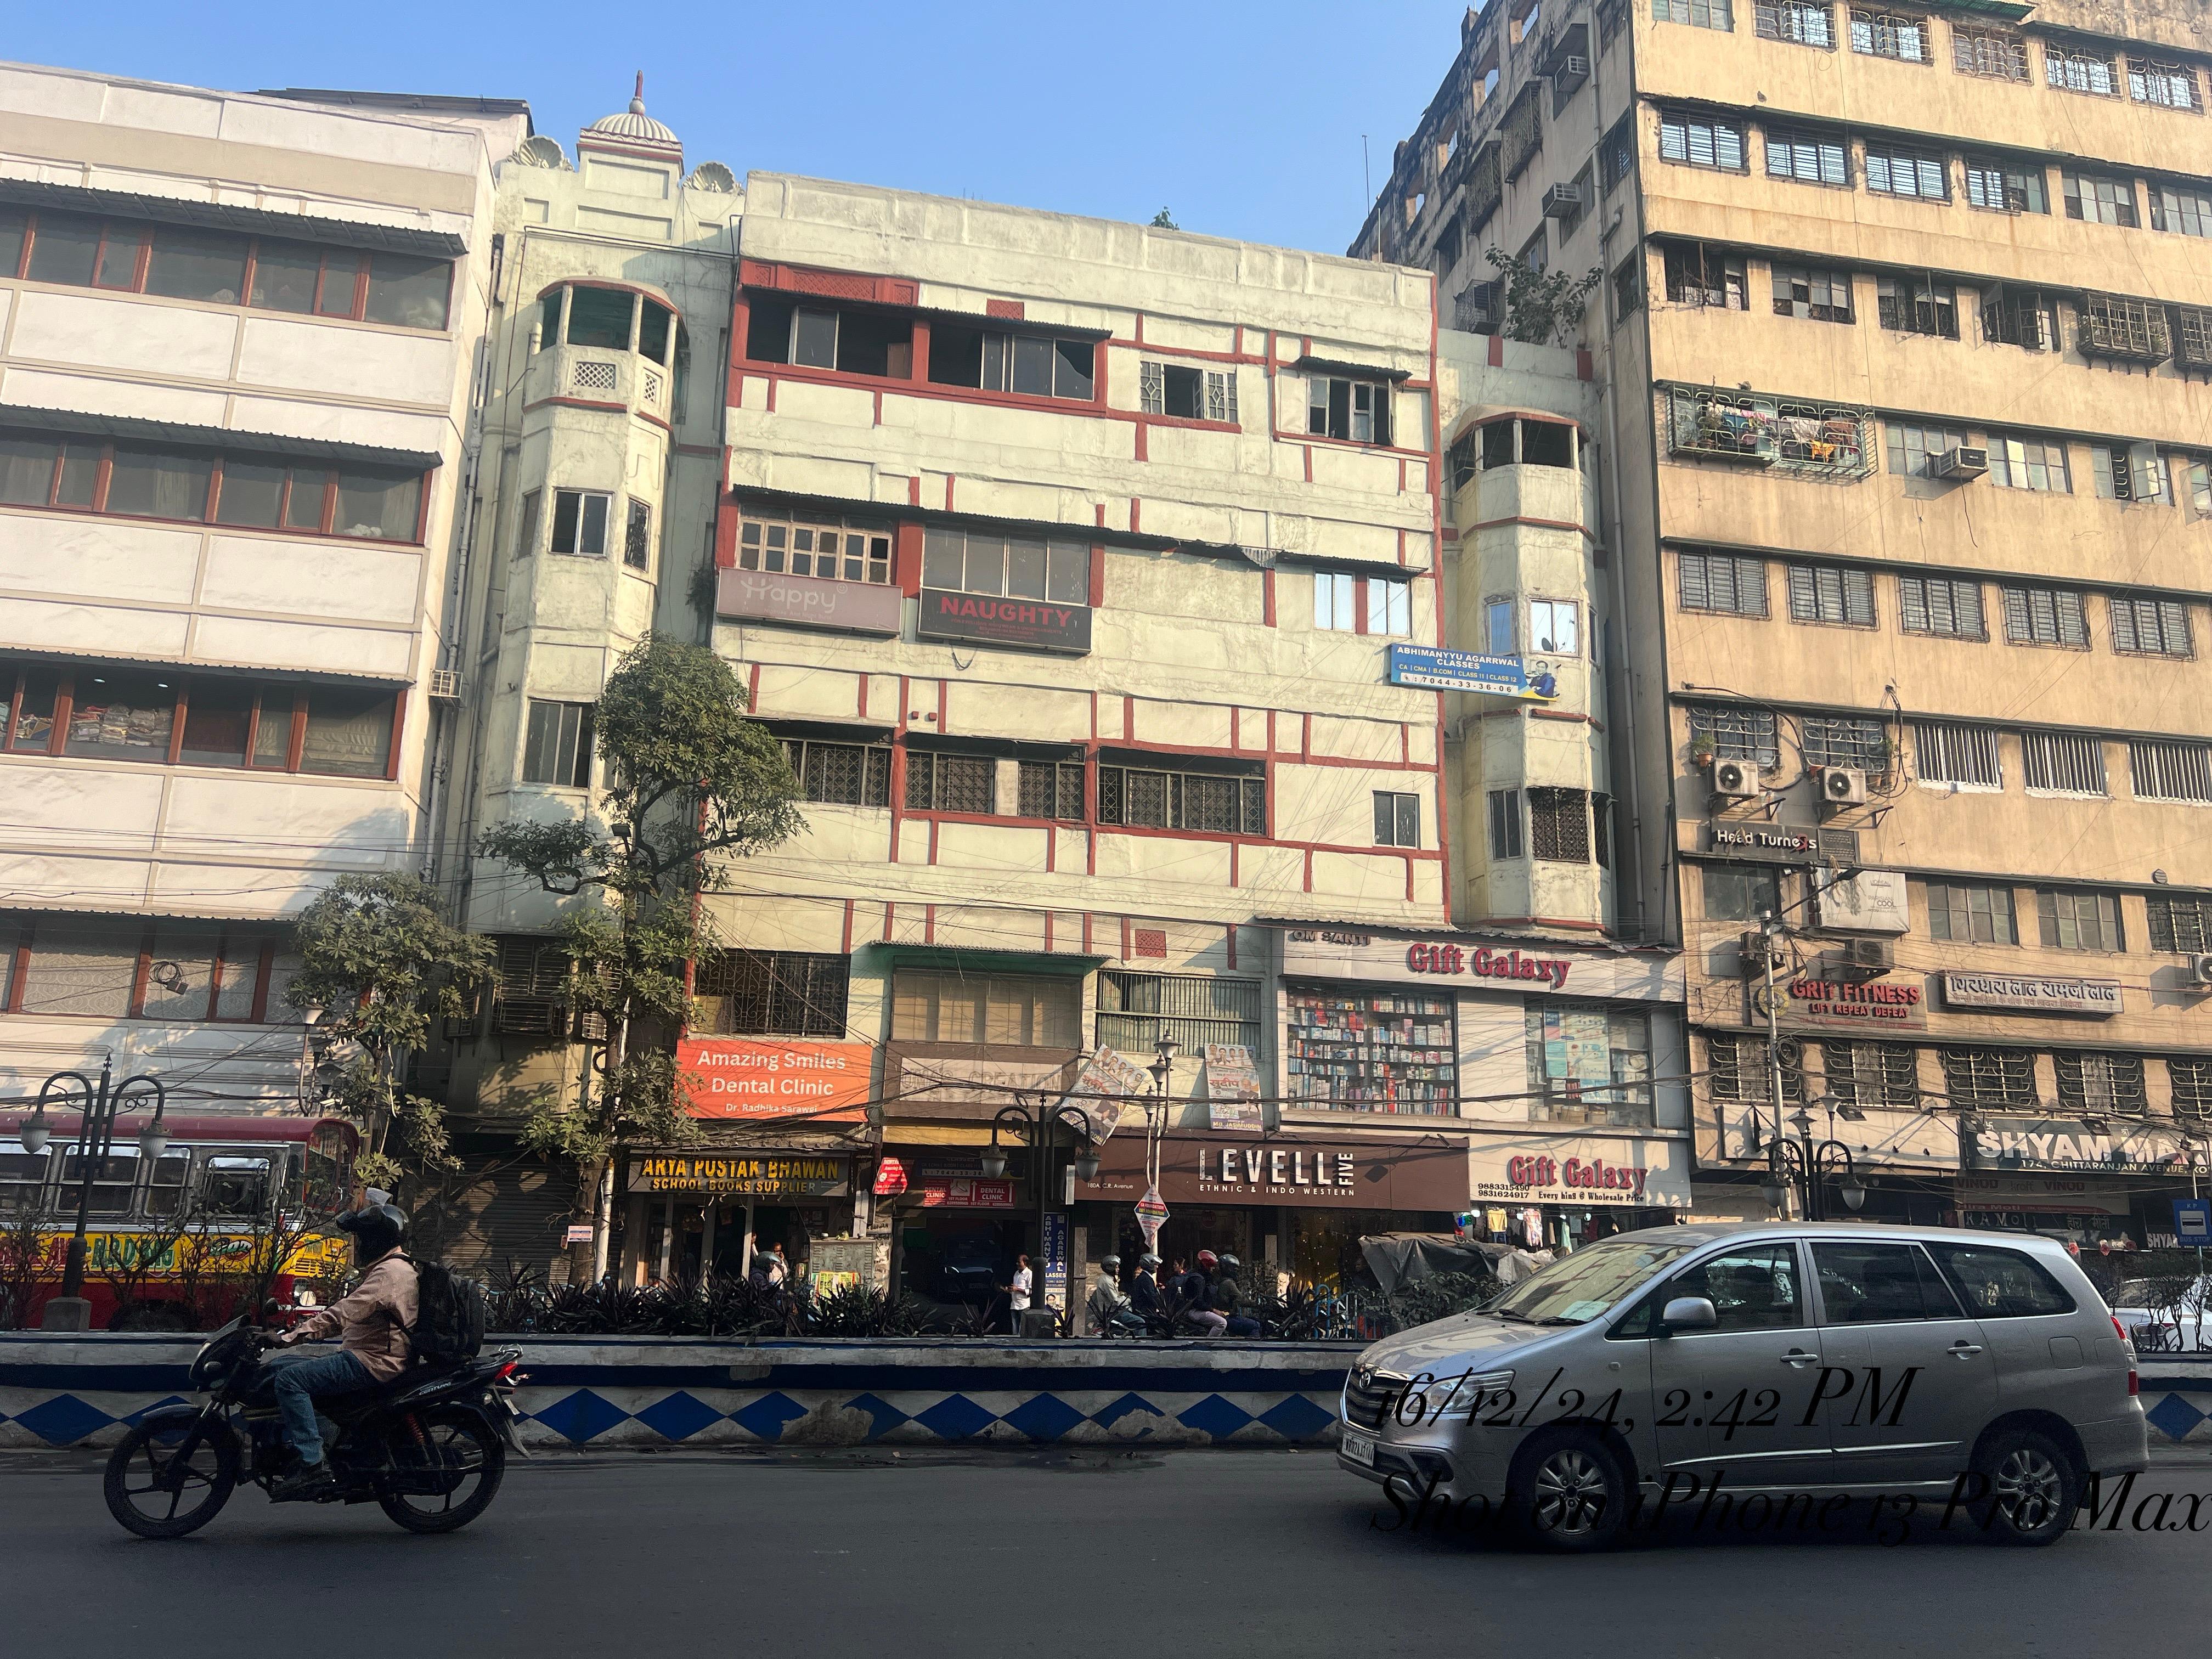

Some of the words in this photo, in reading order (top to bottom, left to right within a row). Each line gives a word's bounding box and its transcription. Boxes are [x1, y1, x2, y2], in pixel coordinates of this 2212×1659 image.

[741, 577, 836, 614] Happy
[940, 596, 1073, 628] NAUGHTY
[1397, 647, 1463, 661] ABHIMANYYU
[1465, 654, 1519, 667] AGARRWAL
[1436, 658, 1480, 669] CLASSES
[1717, 829, 1753, 844] Head
[1293, 930, 1318, 940] OM
[1409, 942, 1465, 974] Gift
[1475, 946, 1572, 988] Galaxy
[1792, 980, 1837, 999] GRIT
[1843, 983, 1920, 1005] FITNESS
[2010, 979, 2037, 997] लाल
[2088, 985, 2115, 1001] लाल
[1810, 1003, 1832, 1014] LIFT
[1836, 1004, 1870, 1015] REPEAT
[1875, 1007, 1910, 1018] DEFEAT
[697, 1050, 779, 1071] Amazing
[783, 1053, 845, 1069] Smiles
[712, 1077, 775, 1094] Dental
[780, 1079, 834, 1096] Clinic
[725, 1103, 740, 1111] Dr.
[742, 1103, 779, 1112] Radhika
[781, 1105, 817, 1113] Sarawgi
[1976, 1130, 2114, 1162] SHYAM
[642, 1158, 686, 1177] ARYA
[694, 1159, 760, 1178] PUSTAK
[767, 1159, 839, 1179] BHAWAN
[1199, 1148, 1331, 1185] LEVELL
[1338, 1153, 1354, 1186] FIVE
[1511, 1155, 1558, 1186] Gift
[1566, 1158, 1648, 1195] Galaxy
[2022, 1159, 2046, 1169] 174,
[2051, 1160, 2137, 1173] CHITTARANJAN
[2141, 1163, 2188, 1174] AVENUE,
[2193, 1164, 2210, 1175] KO
[653, 1178, 703, 1190] SCHOOL
[708, 1180, 752, 1192] BOOKS
[756, 1180, 816, 1193] SUPPLIER
[1200, 1184, 1243, 1193] ETHNIC
[1304, 1188, 1355, 1196] WESTERN
[1477, 1183, 1530, 1191] 9883315490
[1957, 1178, 1999, 1189] VINOD
[2043, 1180, 2085, 1190] VINOD
[1478, 1189, 1530, 1199] 9831624917
[1538, 1190, 1559, 1200] Every
[1588, 1192, 1624, 1201] Wholesale
[1626, 1193, 1644, 1202] Price
[1056, 1229, 1065, 1272] AGARRWAL
